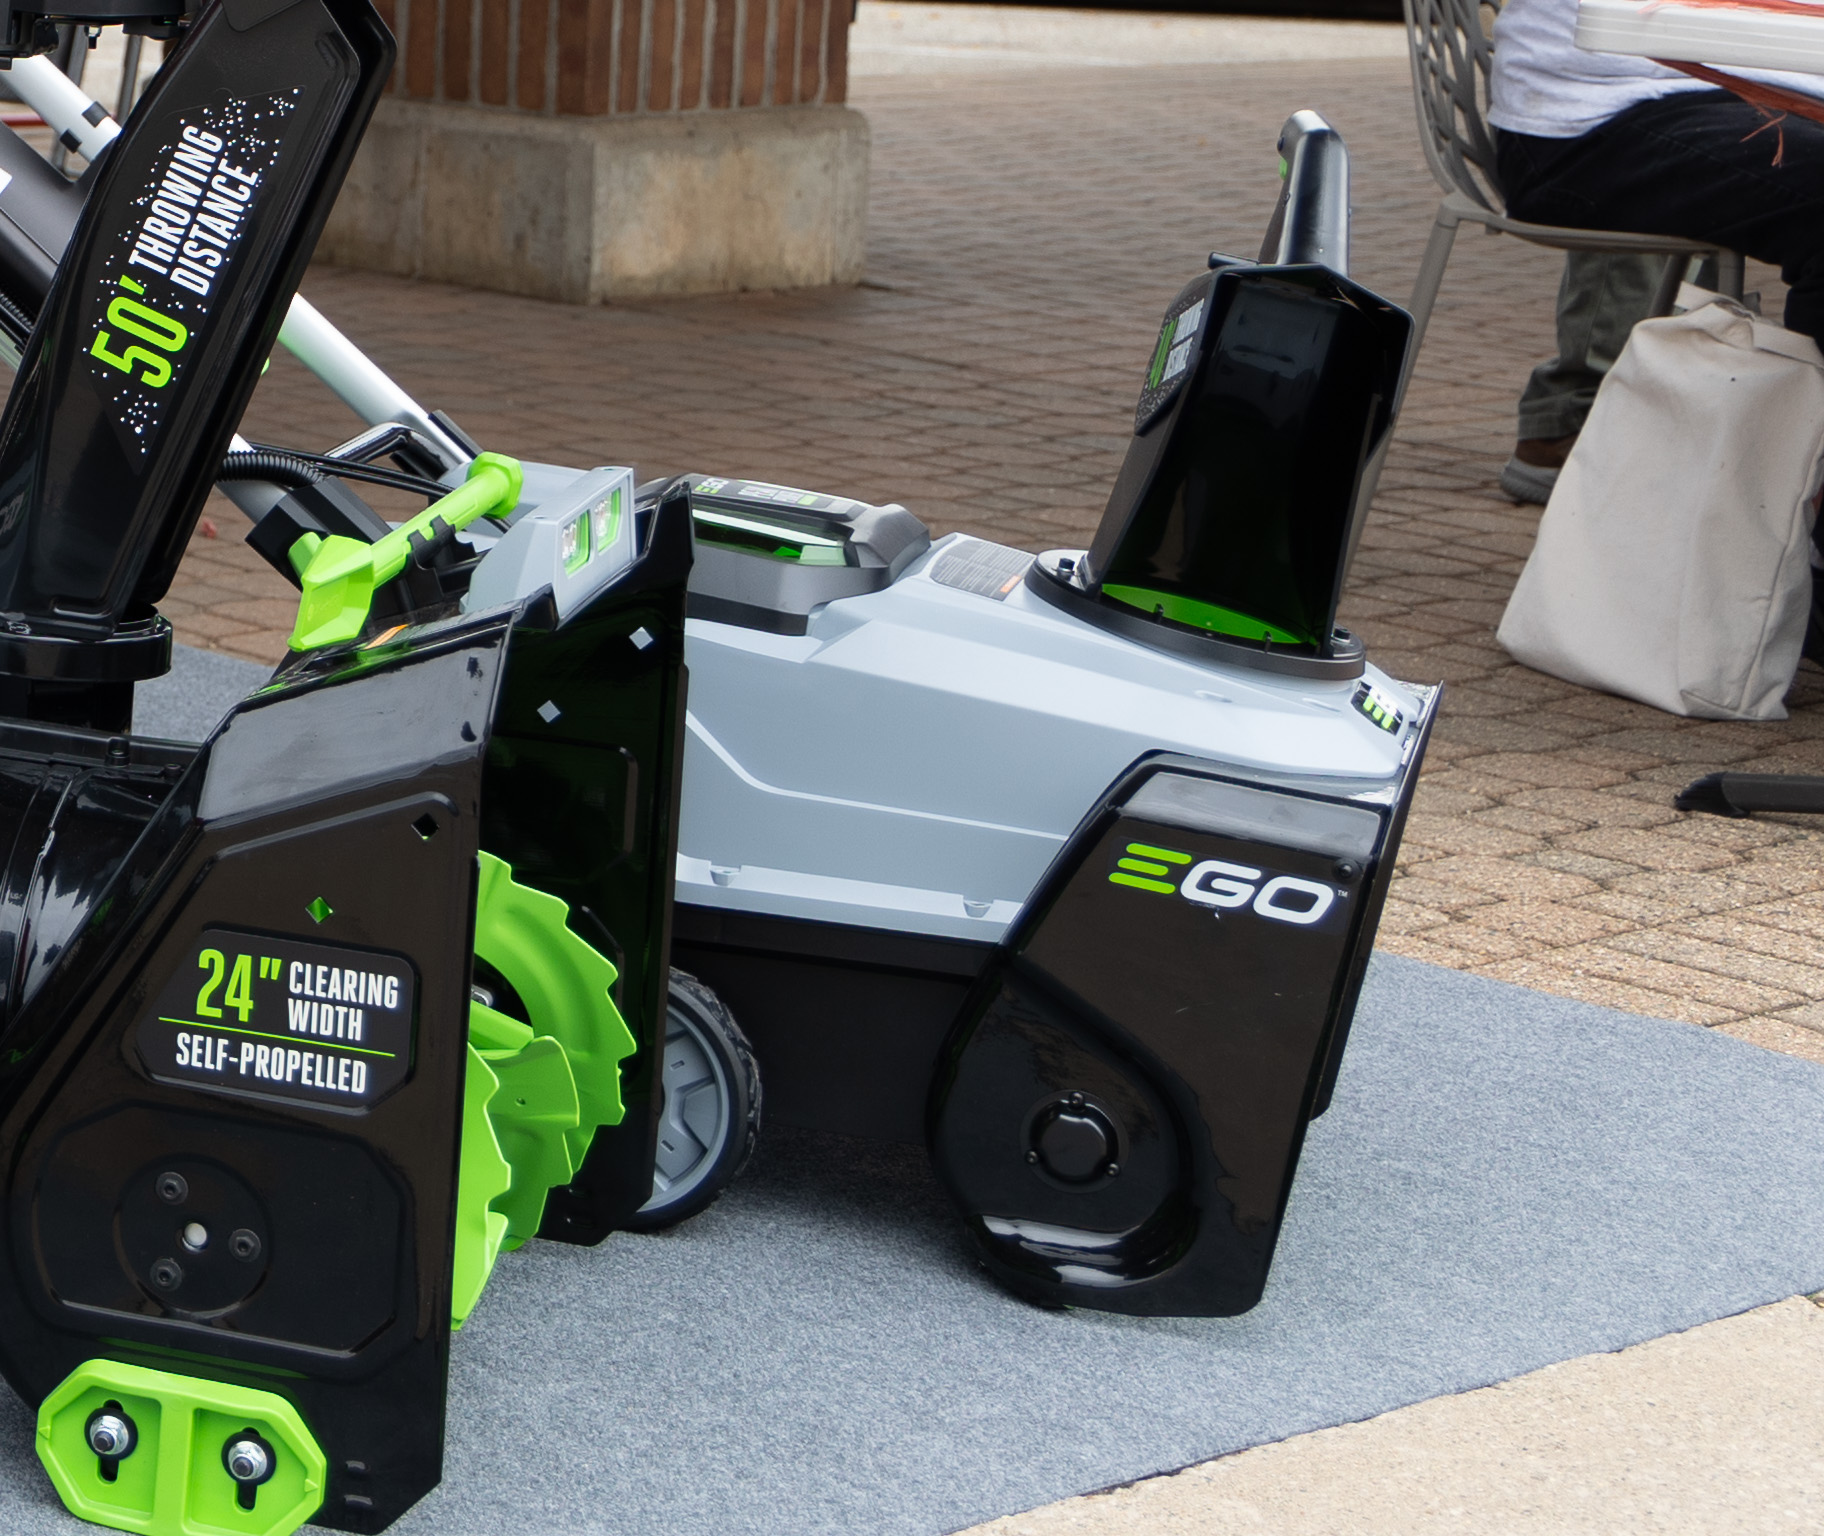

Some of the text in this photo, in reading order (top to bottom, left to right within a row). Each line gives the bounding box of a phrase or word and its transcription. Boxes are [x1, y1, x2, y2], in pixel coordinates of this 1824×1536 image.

[128, 125, 223, 275] THROWING
[170, 158, 259, 296] DISTANCE
[89, 274, 188, 388] 50'
[1108, 842, 1334, 926] EGO
[196, 948, 400, 1022] 24" CLEARING
[288, 996, 364, 1041] WIDTH
[175, 1032, 367, 1095] SELF-PROPELLED
